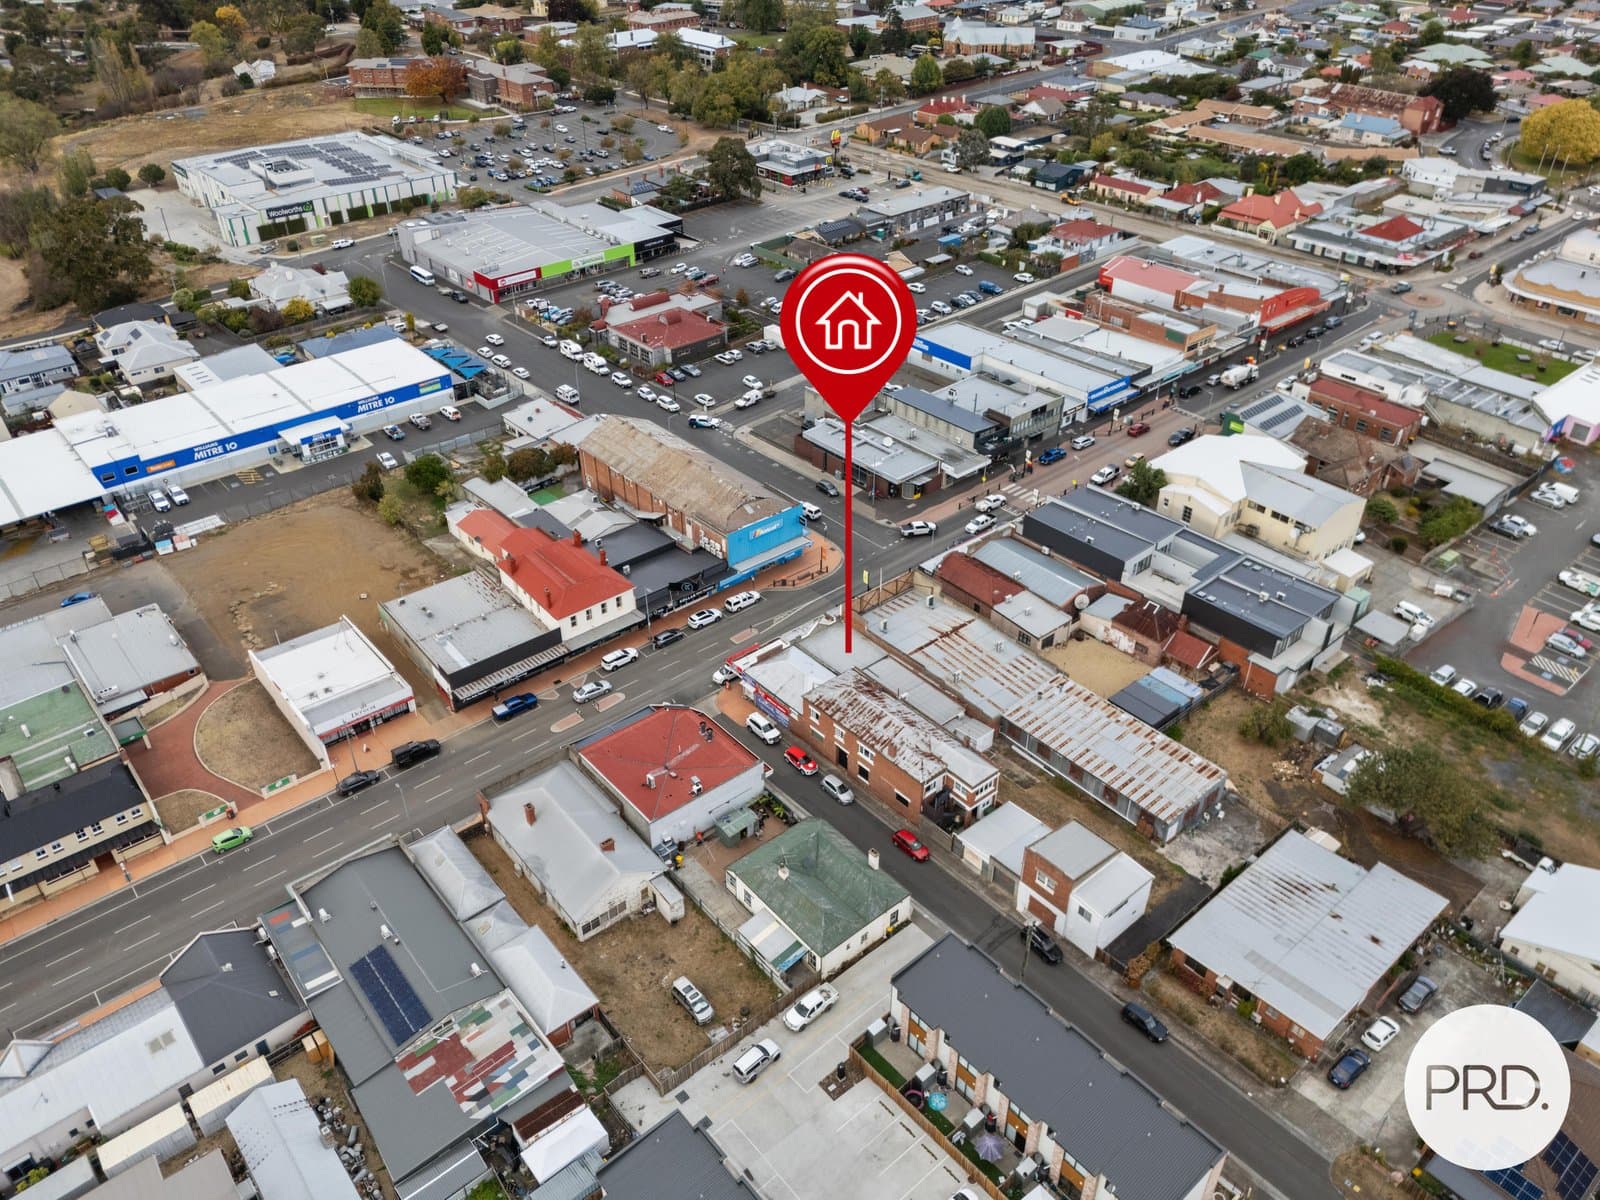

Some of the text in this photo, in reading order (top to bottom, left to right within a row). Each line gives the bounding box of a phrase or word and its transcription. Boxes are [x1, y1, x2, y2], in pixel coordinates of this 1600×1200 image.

[269, 206, 303, 217] Woolworths
[357, 396, 395, 413] MITRE 10
[193, 442, 219, 452] WILLIAMS
[194, 441, 238, 461] MITRE 10
